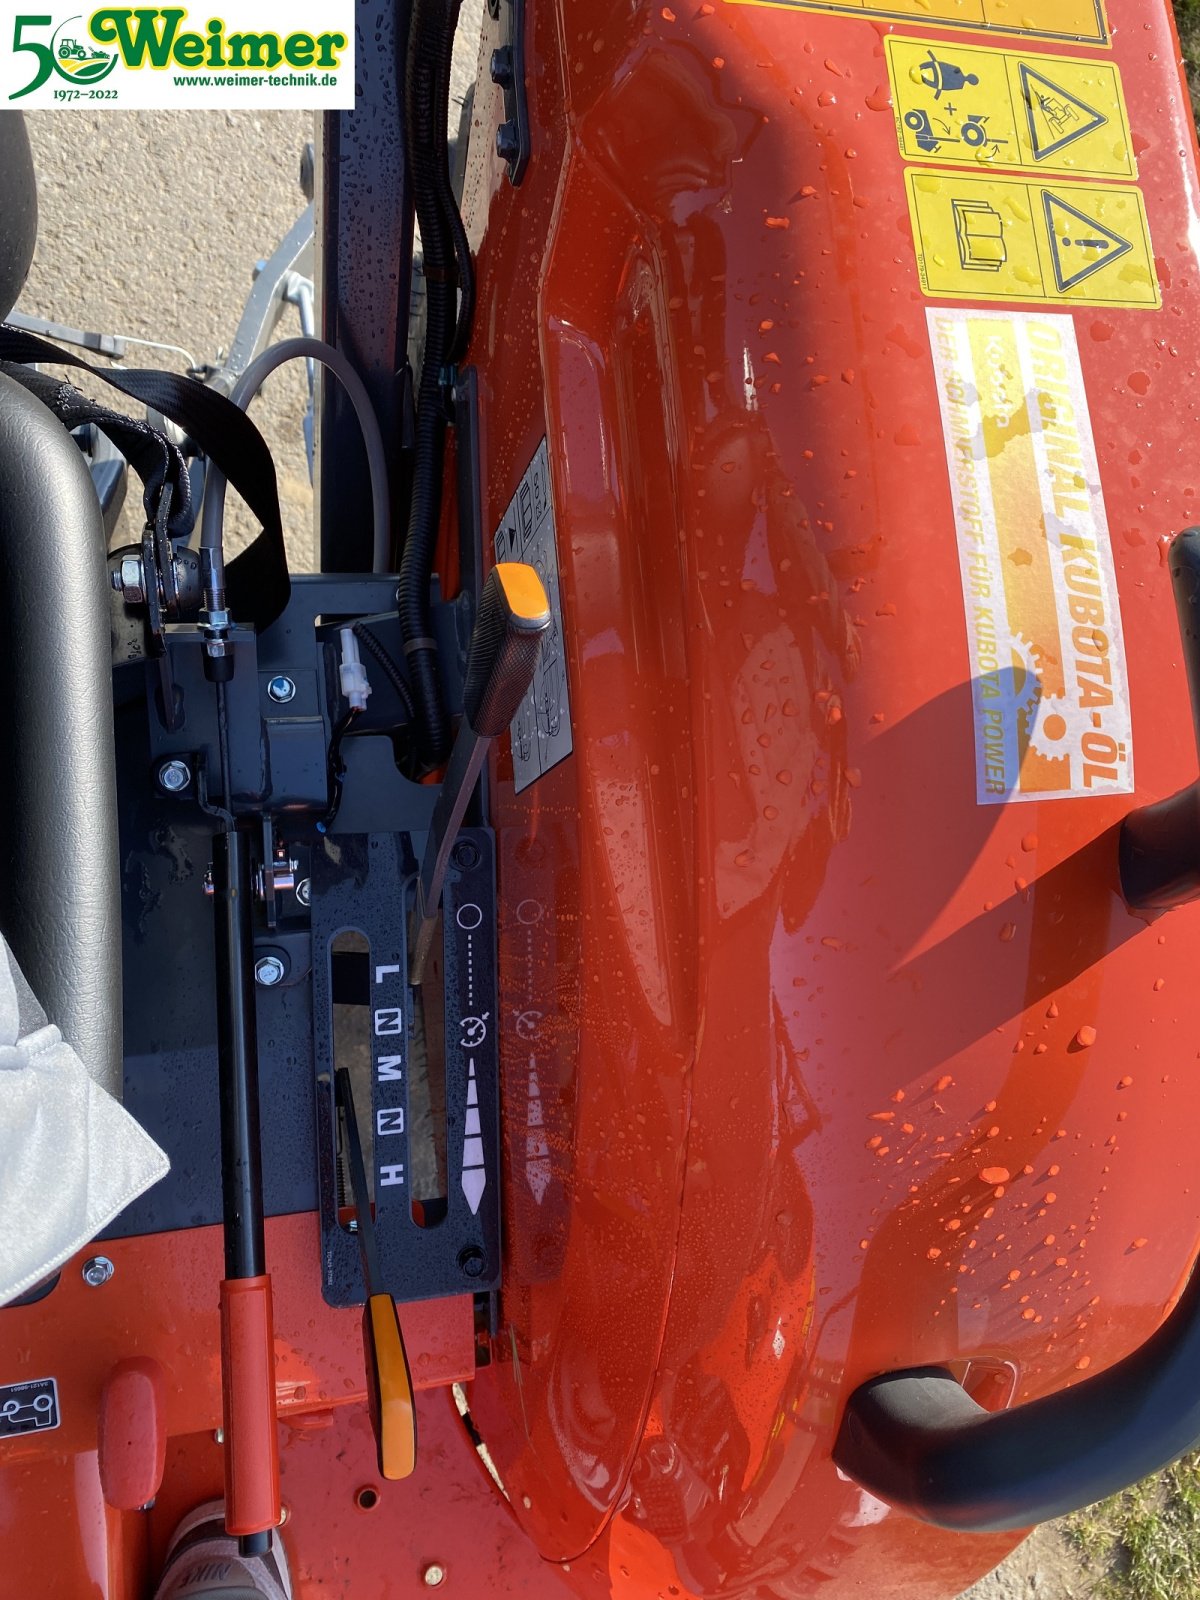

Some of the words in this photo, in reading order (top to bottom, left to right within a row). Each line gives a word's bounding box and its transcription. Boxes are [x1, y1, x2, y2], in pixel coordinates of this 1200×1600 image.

[935, 317, 956, 362] DER
[986, 338, 1011, 428] Kubota
[942, 367, 982, 544] SCHMIERSTOFF
[968, 551, 991, 597] FÜR
[1028, 323, 1090, 520] ORIGINAL
[1059, 533, 1126, 789] KUBOTA-ÖL
[974, 605, 999, 699] KUBOTA
[981, 708, 1005, 796] POWER
[376, 964, 400, 983] L
[377, 1010, 401, 1032] N
[378, 1055, 402, 1081] M
[379, 1109, 402, 1133] N
[380, 1165, 404, 1186] H
